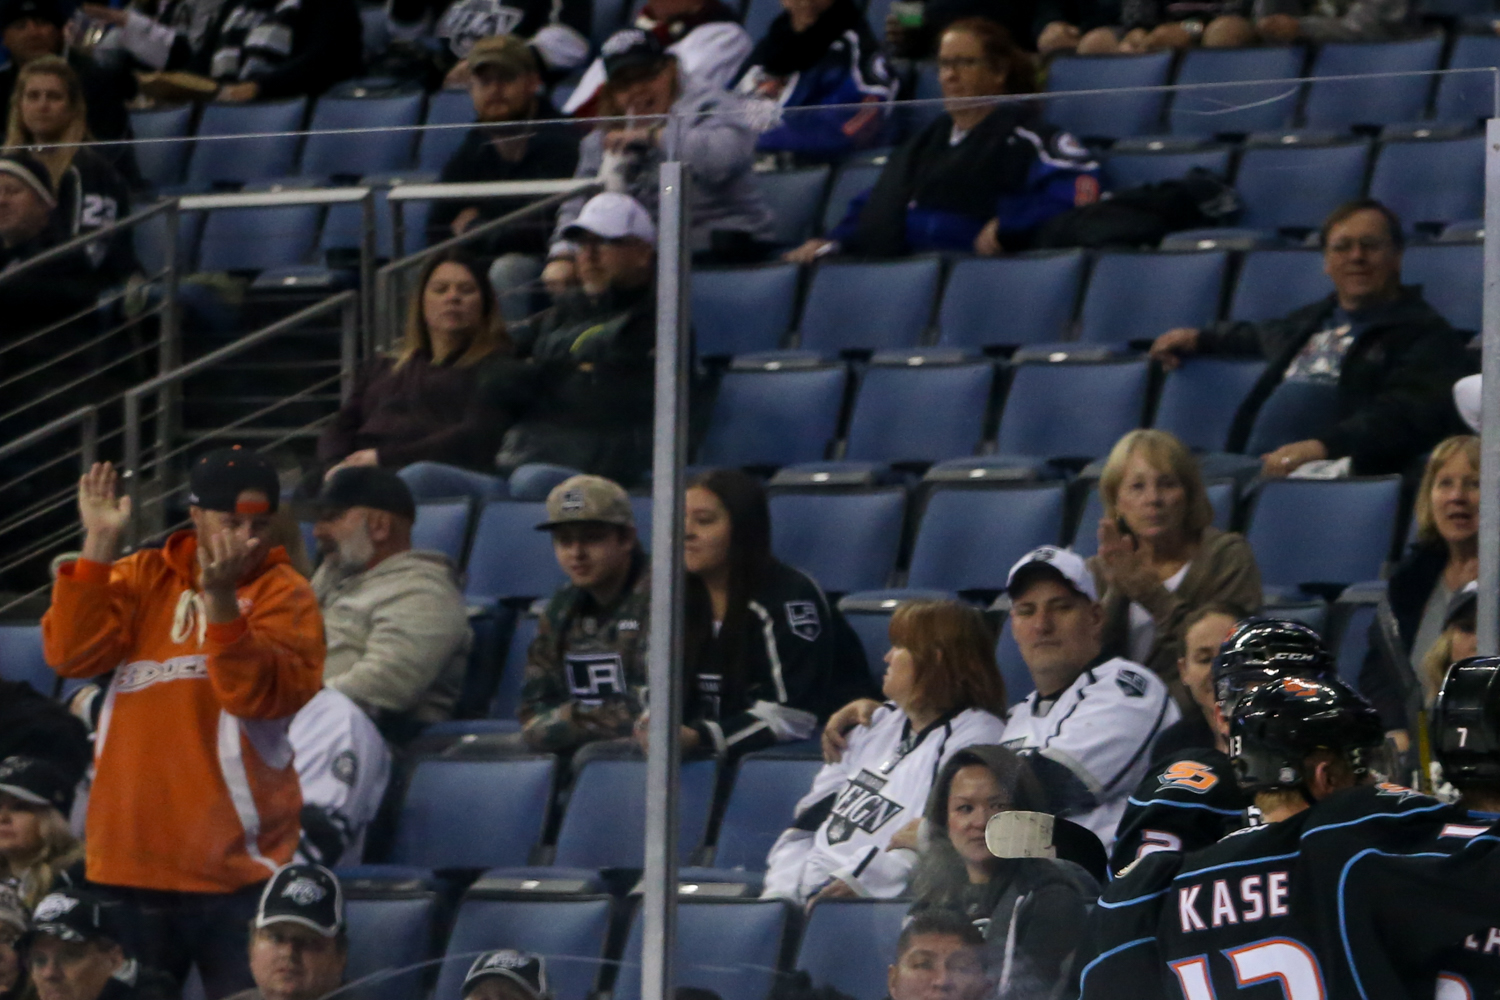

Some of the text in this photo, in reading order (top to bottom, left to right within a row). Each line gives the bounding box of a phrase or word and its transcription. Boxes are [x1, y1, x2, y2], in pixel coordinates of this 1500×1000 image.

[565, 654, 628, 698] LA
[1275, 652, 1314, 662] CCM
[1456, 727, 1468, 747] 7
[832, 784, 901, 832] EIGN
[1177, 870, 1290, 934] KASE
